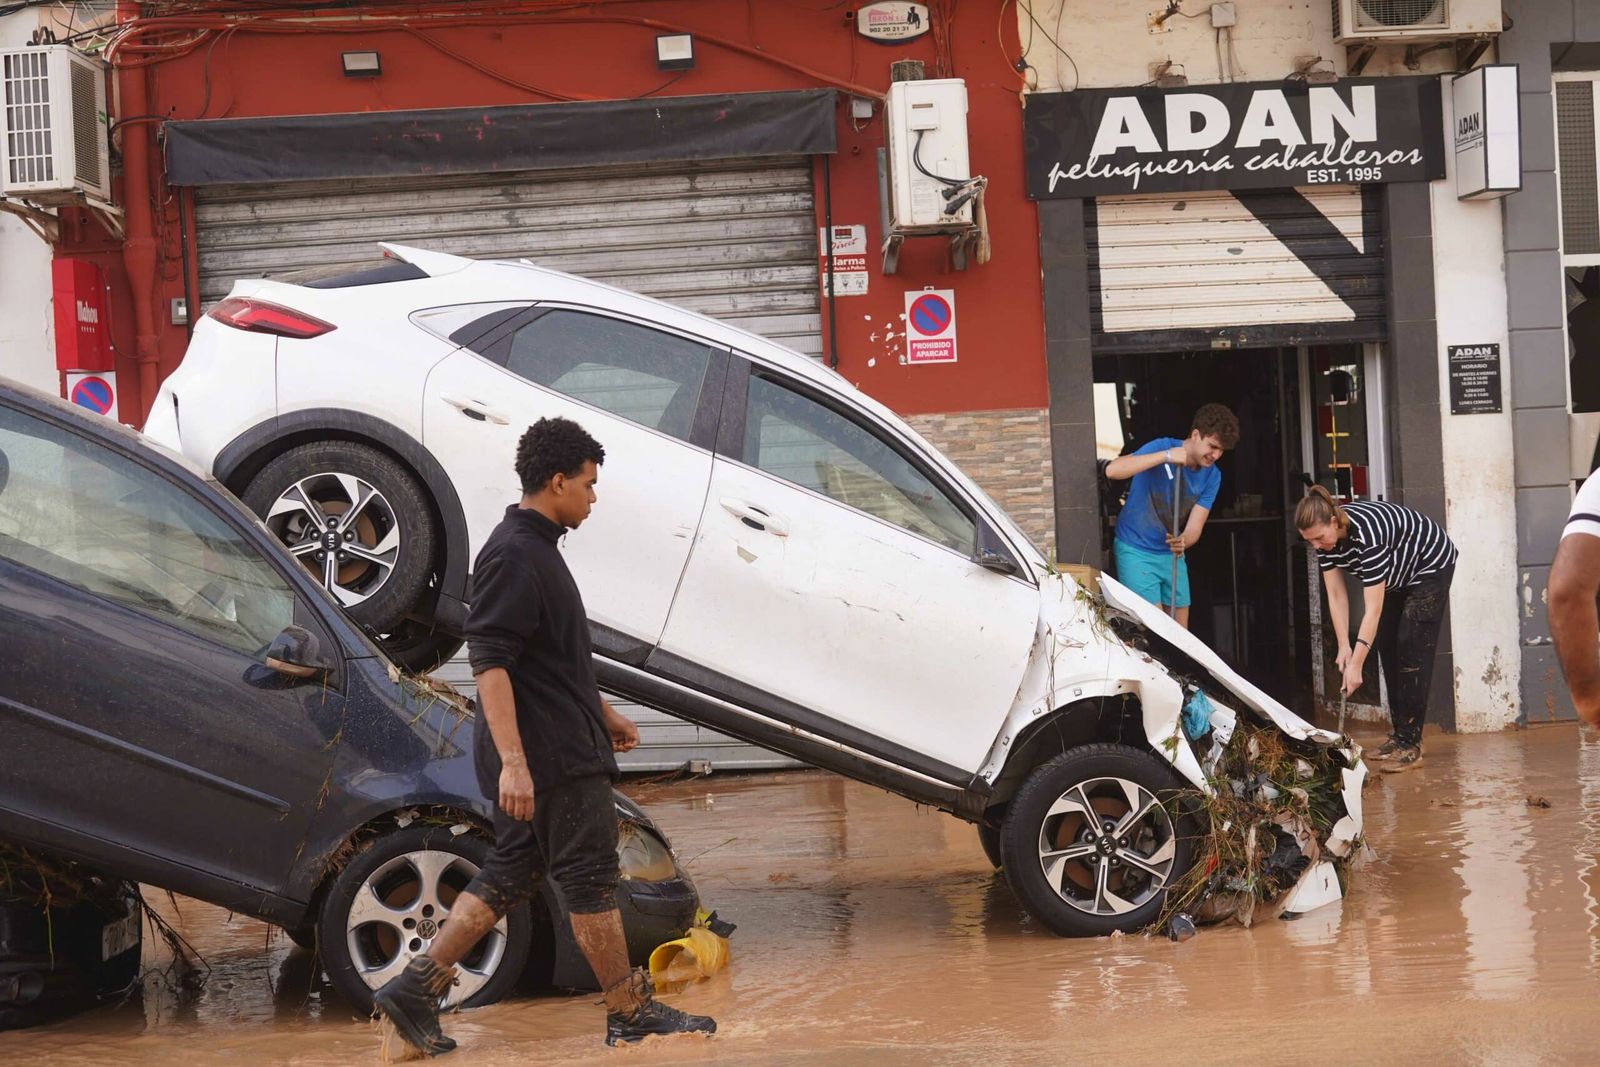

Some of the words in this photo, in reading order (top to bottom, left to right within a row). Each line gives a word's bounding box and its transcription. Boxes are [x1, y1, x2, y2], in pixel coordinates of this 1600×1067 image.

[1090, 85, 1377, 156] ADAN
[1458, 111, 1479, 137] ADAN
[1048, 150, 1234, 193] peluquería
[1244, 136, 1422, 171] caballeros
[1307, 169, 1341, 183] EST.
[1346, 167, 1382, 182] 1995
[77, 300, 98, 324] Mahou
[912, 341, 951, 349] PROHIBIDO
[1455, 347, 1492, 357] ADAN
[1101, 837, 1113, 854] KIA
